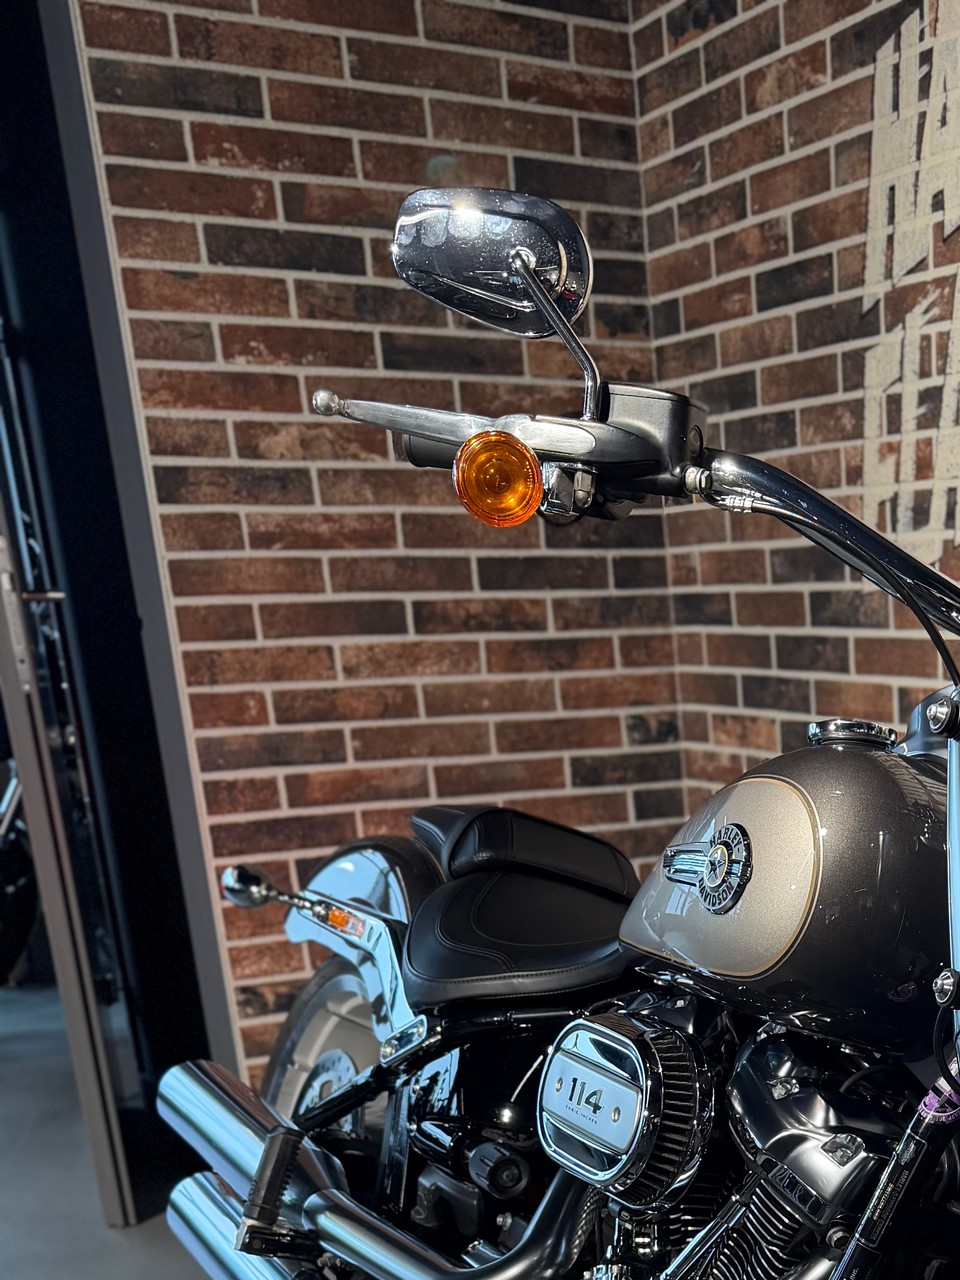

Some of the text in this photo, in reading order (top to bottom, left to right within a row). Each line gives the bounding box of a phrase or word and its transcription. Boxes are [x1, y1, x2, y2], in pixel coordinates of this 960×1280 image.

[699, 877, 735, 907] DAVIDSON
[568, 1077, 603, 1115] 114
[565, 1104, 598, 1125] CUBIC INCHES
